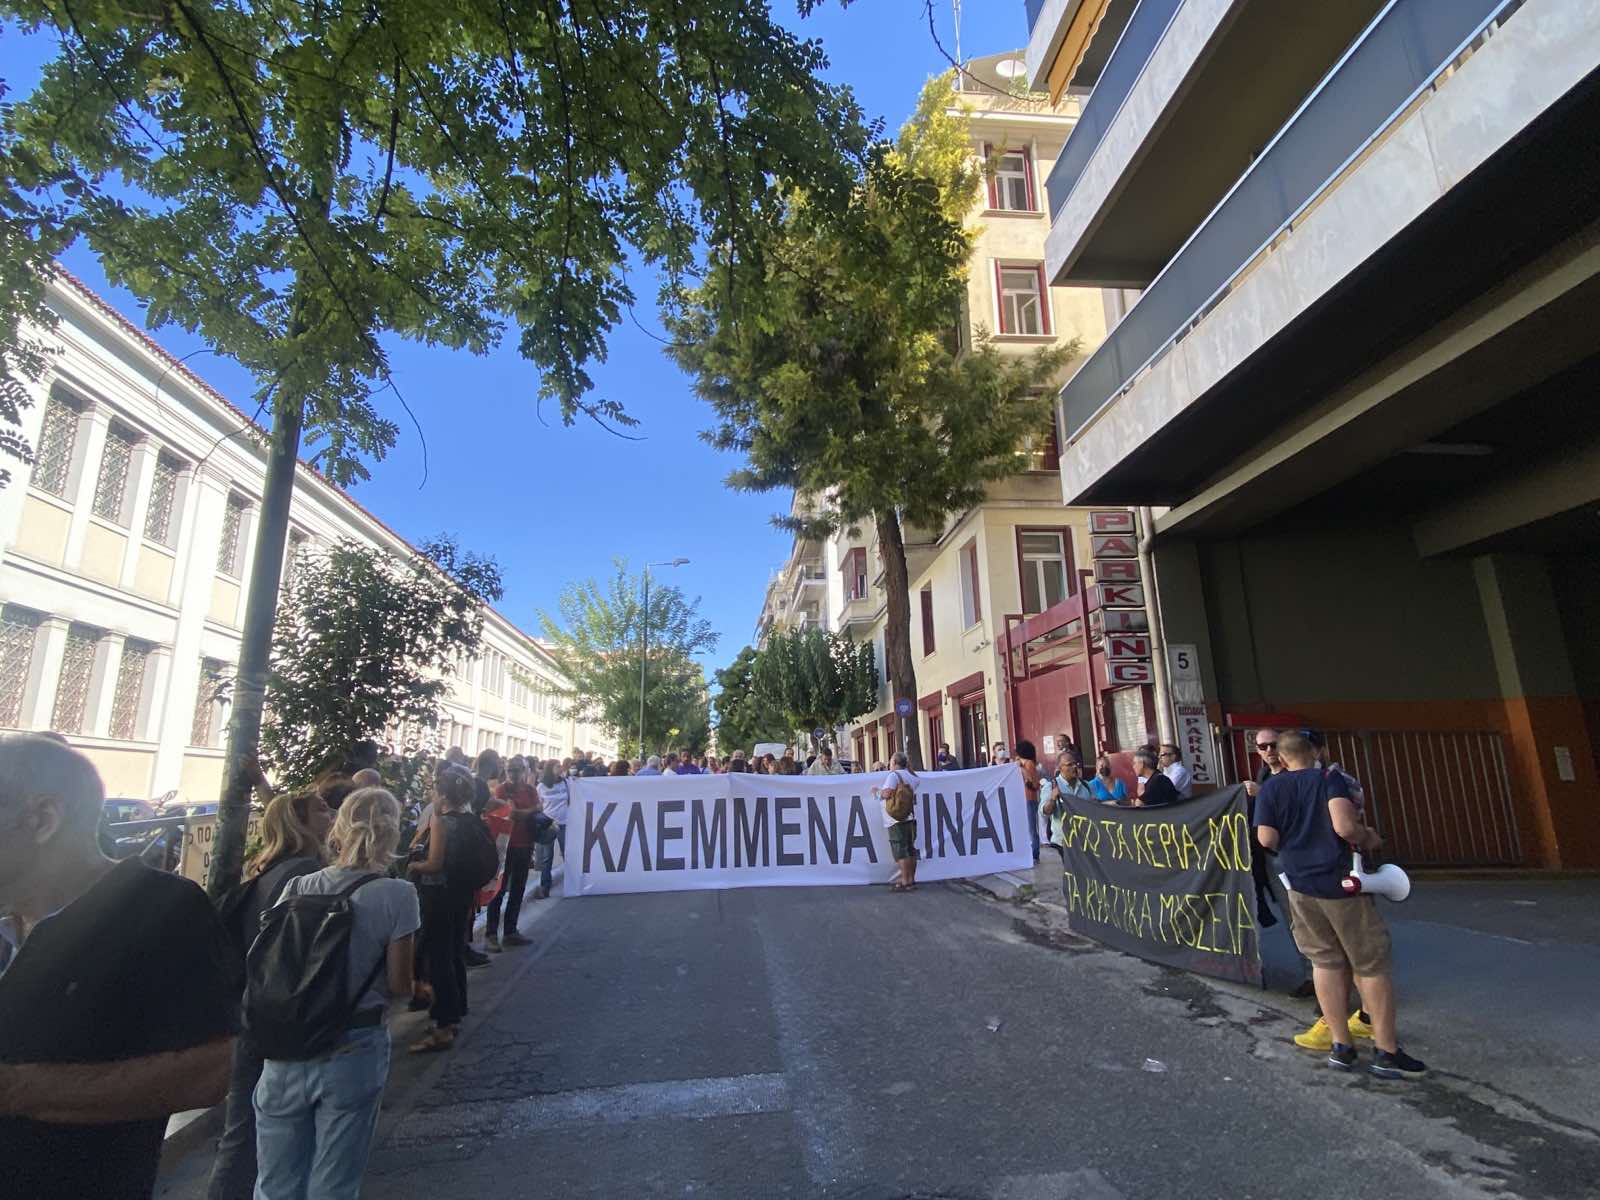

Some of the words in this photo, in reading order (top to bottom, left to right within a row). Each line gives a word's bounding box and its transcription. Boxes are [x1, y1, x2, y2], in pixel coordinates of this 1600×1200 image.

[1095, 513, 1149, 681] PARKING
[1177, 652, 1190, 670] 5
[1185, 717, 1210, 782] PARKING
[581, 795, 879, 874] ΚΛΕΜΜΕΝΑ
[912, 786, 1014, 861] ΙΝΑΙ
[1100, 820, 1134, 861] ΤΑ
[1203, 812, 1252, 872] ΑΠΟ
[1064, 871, 1085, 917] ΤΑ
